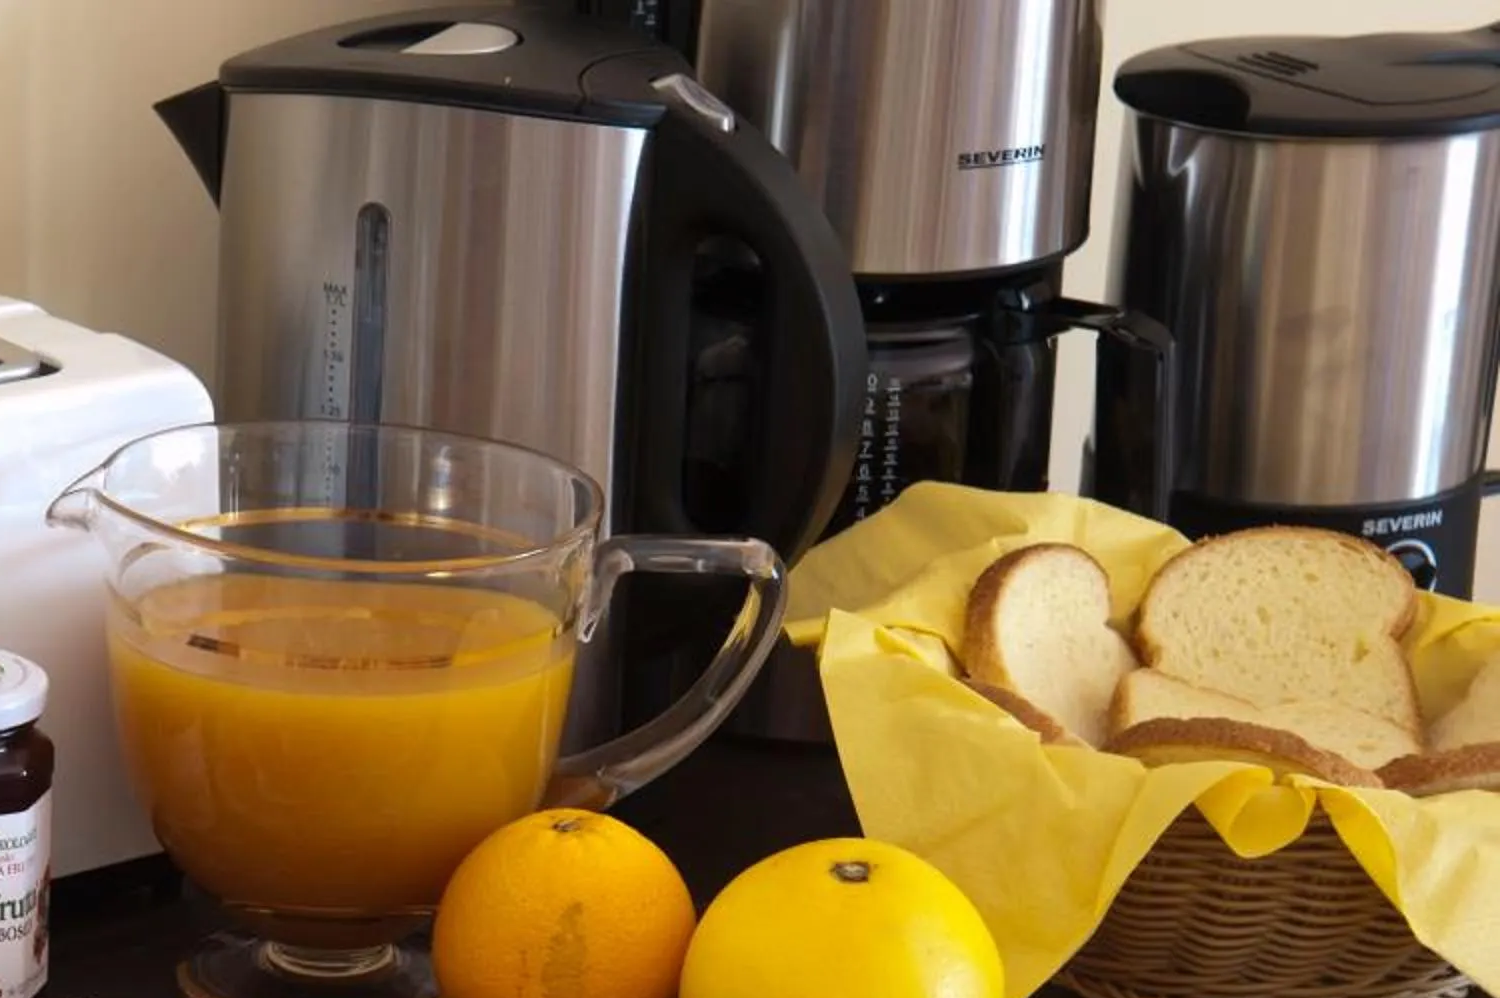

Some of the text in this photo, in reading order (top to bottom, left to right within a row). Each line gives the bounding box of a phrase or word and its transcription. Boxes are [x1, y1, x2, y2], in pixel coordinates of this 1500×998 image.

[957, 145, 1046, 165] SEVERIN
[323, 282, 347, 296] MAX
[1362, 509, 1443, 536] SEVERIN
